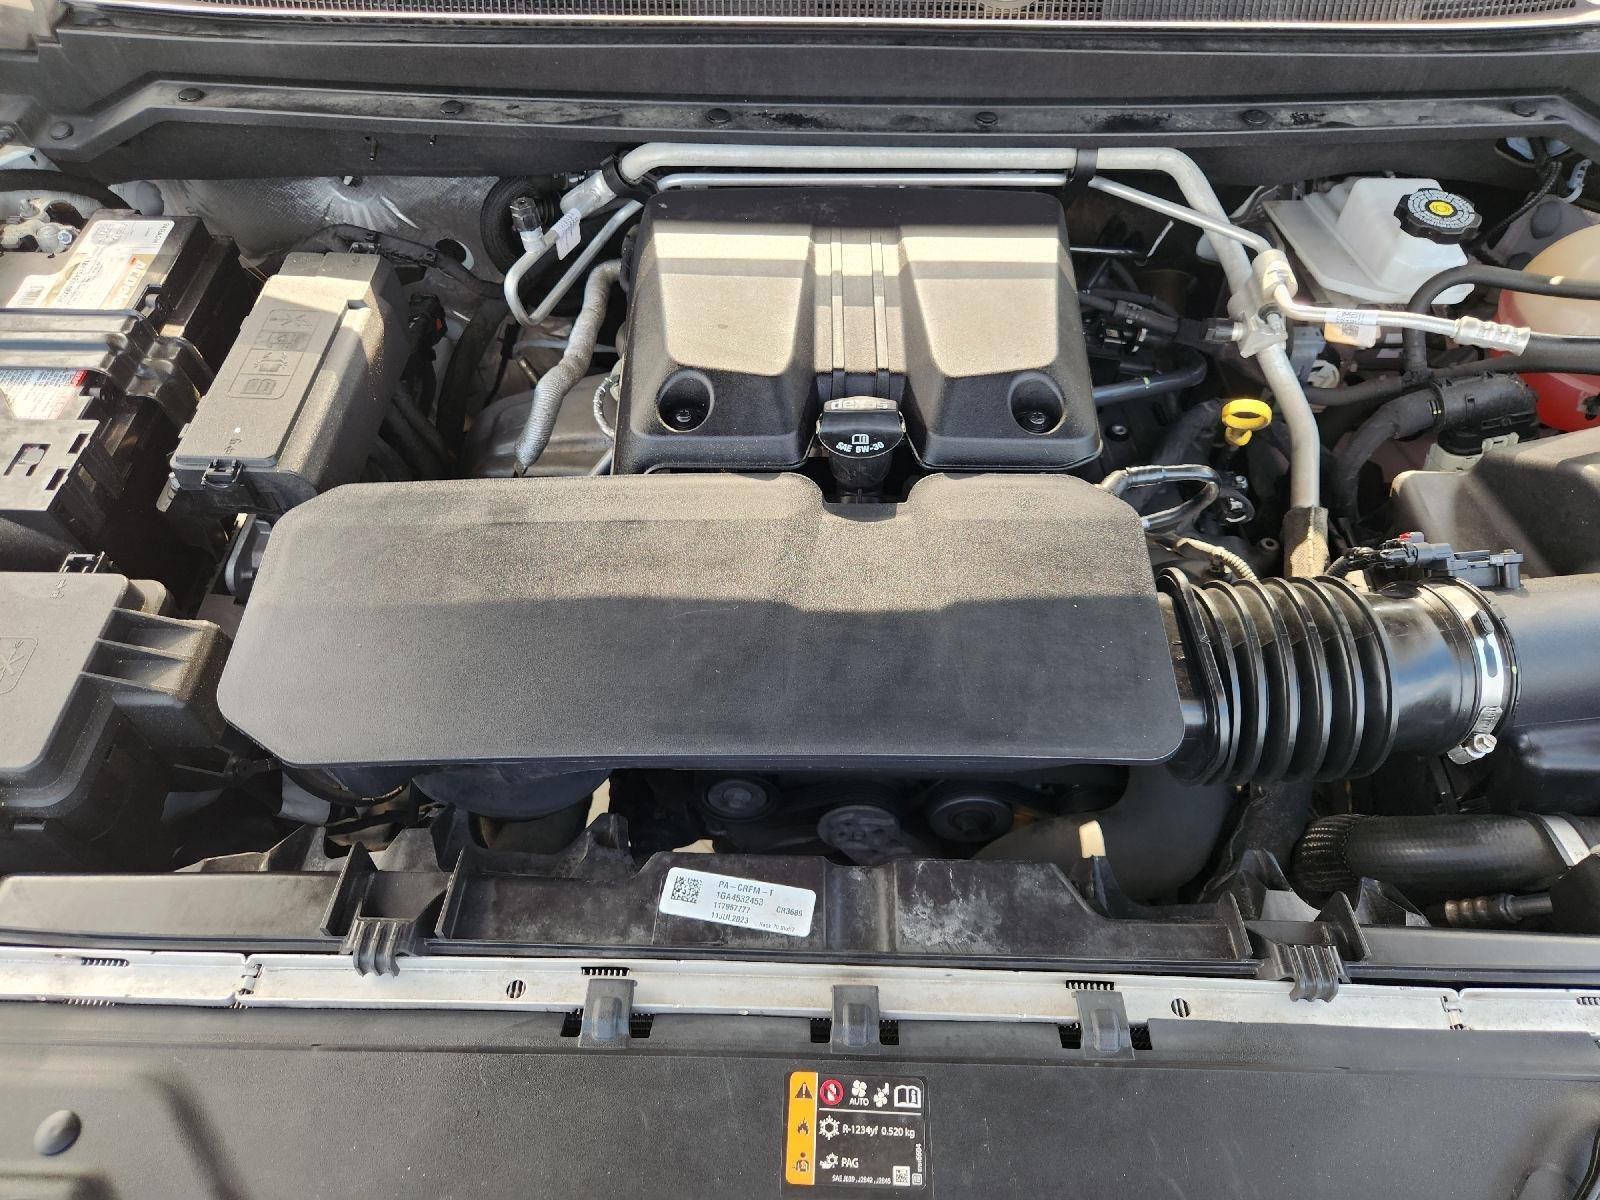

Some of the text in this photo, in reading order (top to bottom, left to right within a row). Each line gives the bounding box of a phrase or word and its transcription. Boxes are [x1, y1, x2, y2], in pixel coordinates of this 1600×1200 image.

[836, 441, 885, 454] SAE 5W-30
[849, 1098, 869, 1107] AUTO
[842, 1124, 916, 1139] R-1234yf 0.520 kg
[841, 1157, 859, 1169] PAG
[832, 1174, 843, 1183] SAE
